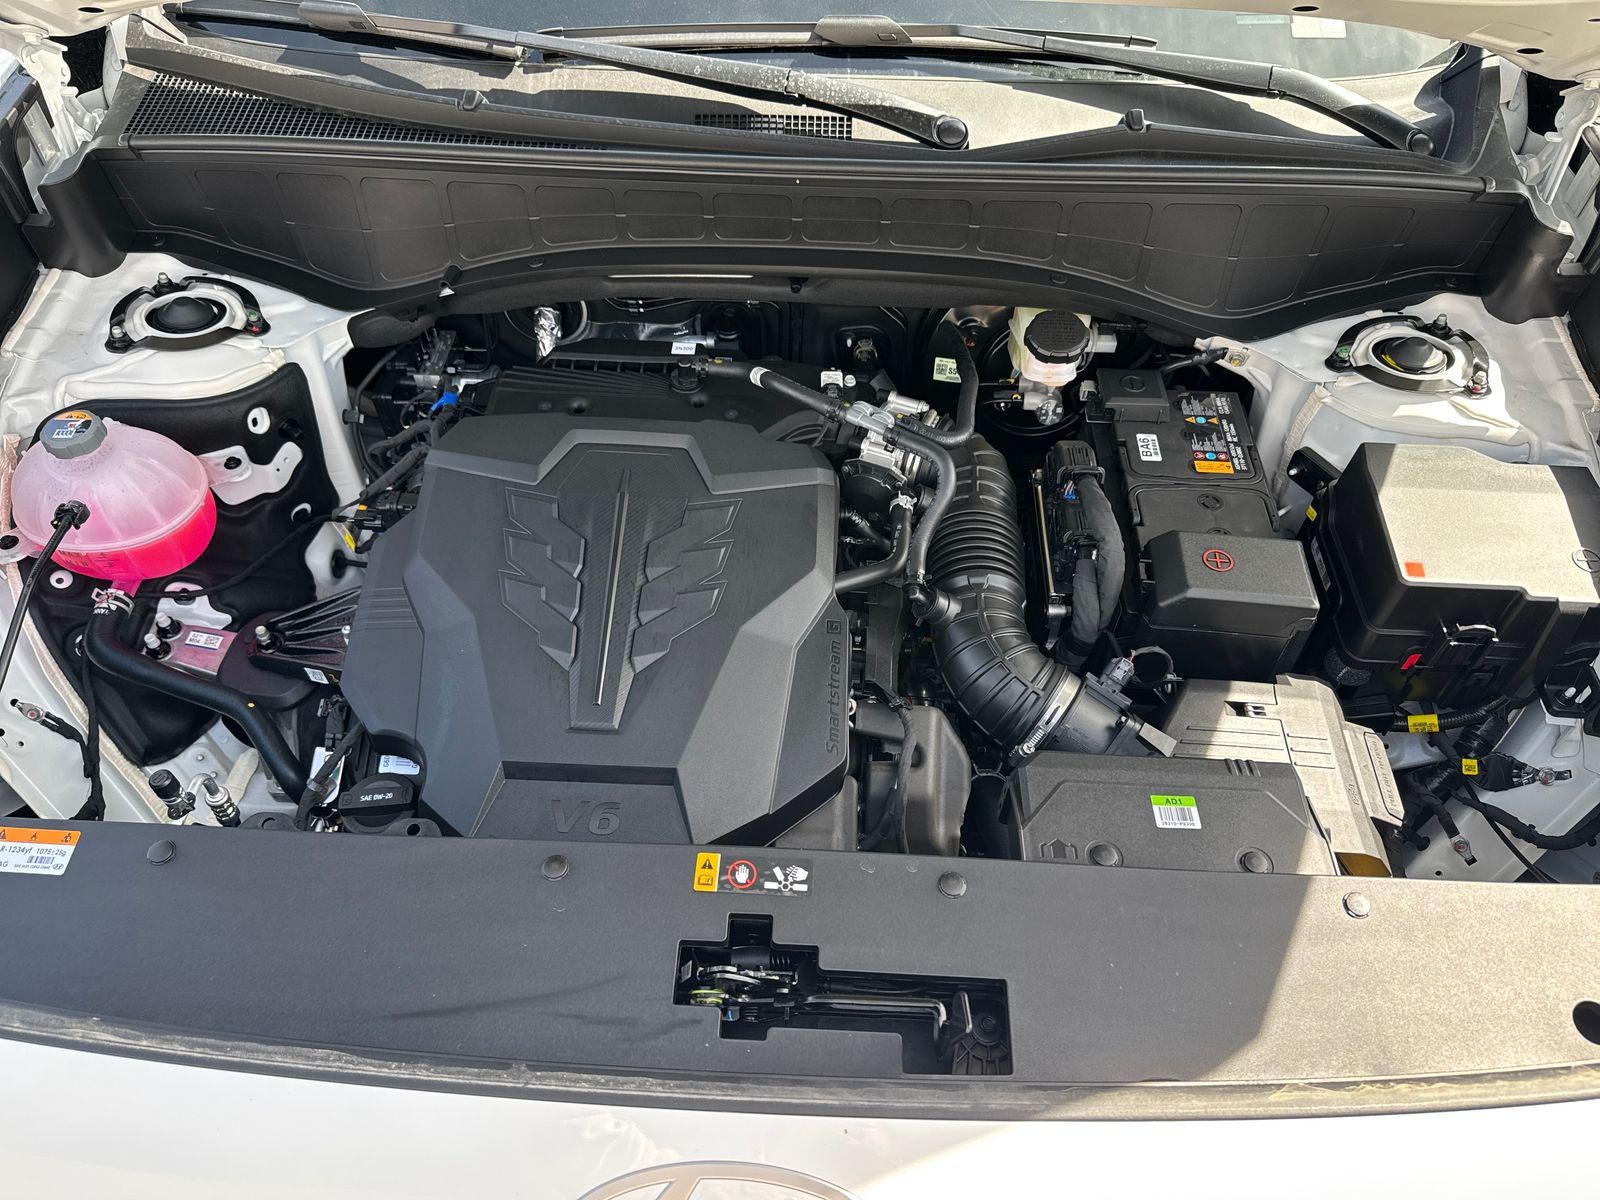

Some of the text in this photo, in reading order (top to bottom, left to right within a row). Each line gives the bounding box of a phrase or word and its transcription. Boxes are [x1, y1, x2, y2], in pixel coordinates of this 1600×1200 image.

[1138, 437, 1153, 457] BA6
[825, 640, 840, 757] Smartstream
[373, 792, 394, 801] 0W-20
[551, 799, 621, 836] V6
[0, 845, 33, 855] R-1234yf
